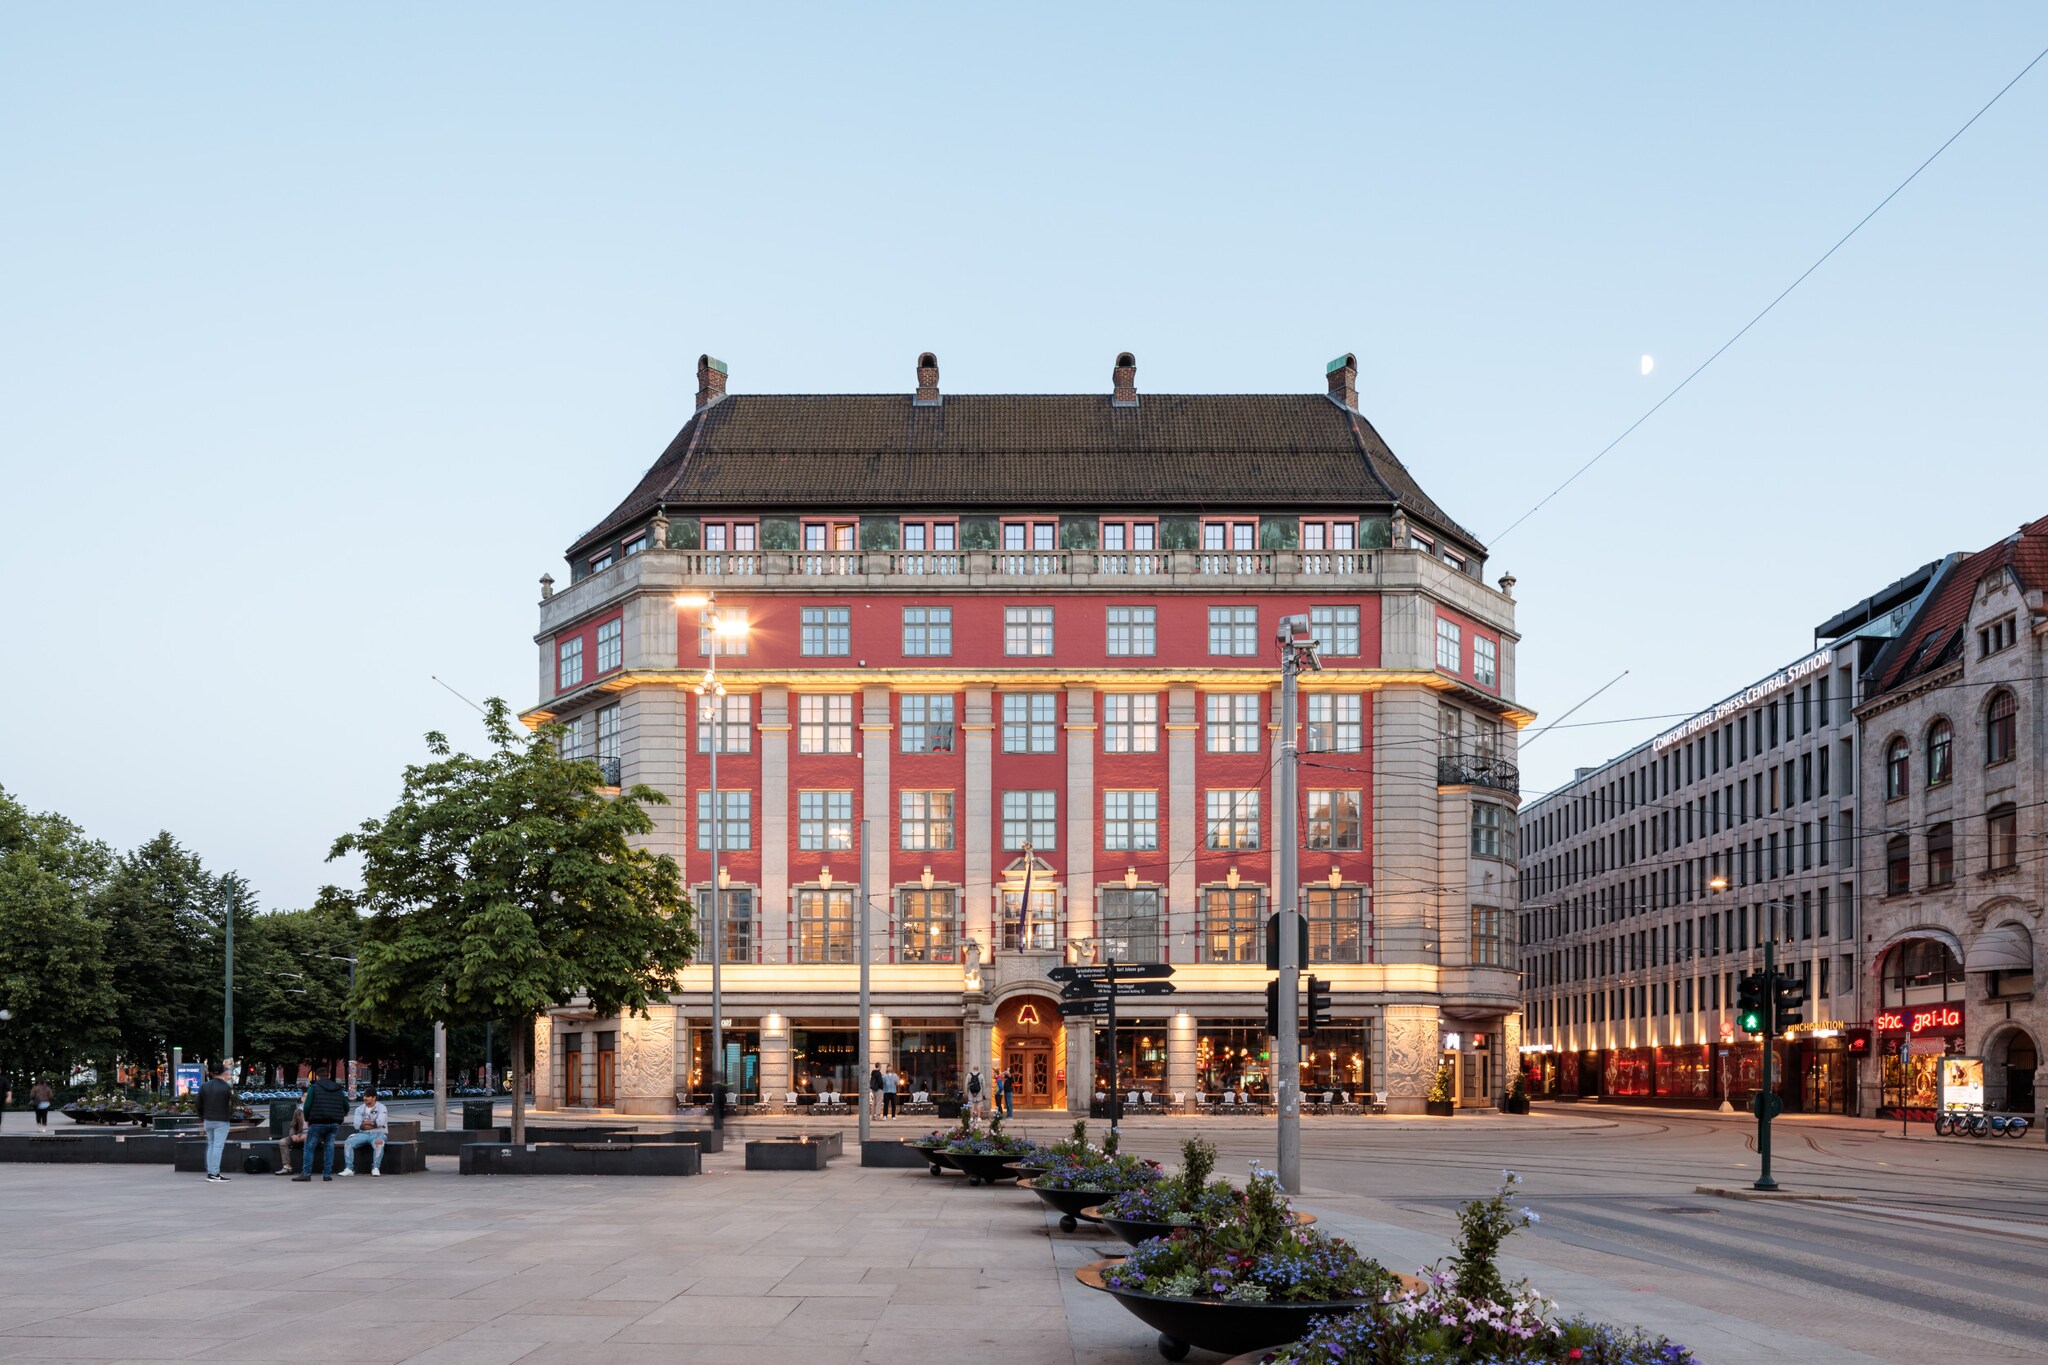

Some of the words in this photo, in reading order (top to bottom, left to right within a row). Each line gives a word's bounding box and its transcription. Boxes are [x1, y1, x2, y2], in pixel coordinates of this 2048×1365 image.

[1653, 724, 1687, 752] COMFORT
[1687, 712, 1714, 735] HOTEL
[1714, 693, 1747, 720] XPRESS
[1746, 673, 1787, 704] CENTRAL
[1787, 650, 1832, 683] STATION
[1017, 1004, 1039, 1024] A
[1817, 1020, 1844, 1031] NATION
